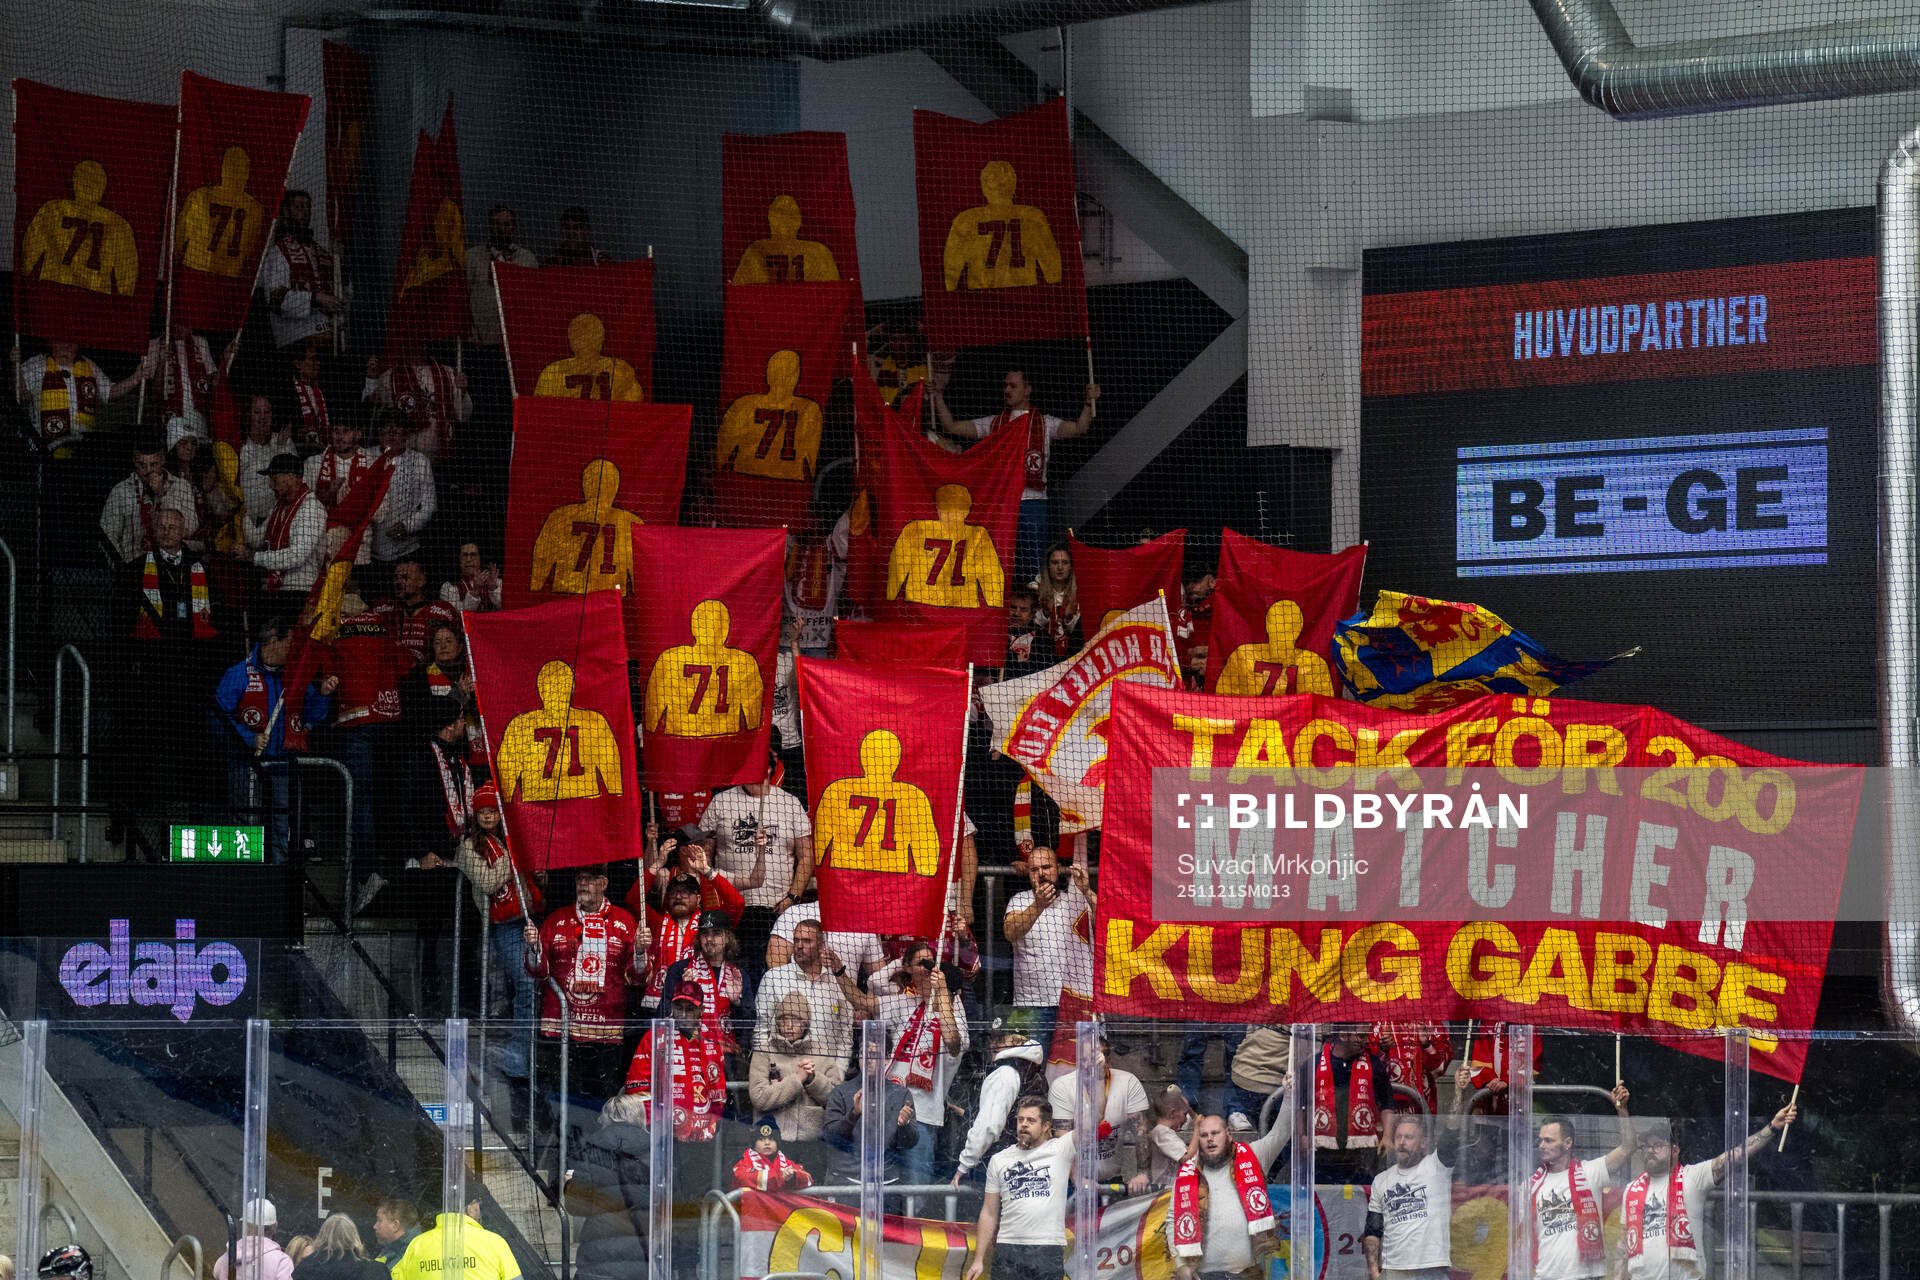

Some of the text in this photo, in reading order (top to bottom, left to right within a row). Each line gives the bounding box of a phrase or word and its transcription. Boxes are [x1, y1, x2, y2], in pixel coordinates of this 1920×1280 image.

[61, 217, 105, 271] 71
[208, 203, 247, 258] 71
[978, 218, 1026, 268] 71
[765, 254, 804, 282] 71
[1513, 294, 1768, 360] HUVUDPARTNER
[565, 372, 612, 401] 71
[754, 408, 798, 461] 71
[1491, 464, 1789, 543] BE-GE
[571, 521, 617, 574] 71
[923, 537, 966, 587] 71
[683, 664, 730, 715] 71
[1254, 660, 1299, 698] 71
[533, 725, 585, 780] 71
[1172, 697, 1797, 835] TACK FÖR 200
[849, 795, 897, 851] 71
[1193, 804, 1755, 951] MATCHER
[58, 917, 248, 1024] elajo
[1104, 918, 1788, 1054] KUNG GABBE
[1031, 1190, 1051, 1198] 1968
[1097, 1244, 1134, 1270] 20
